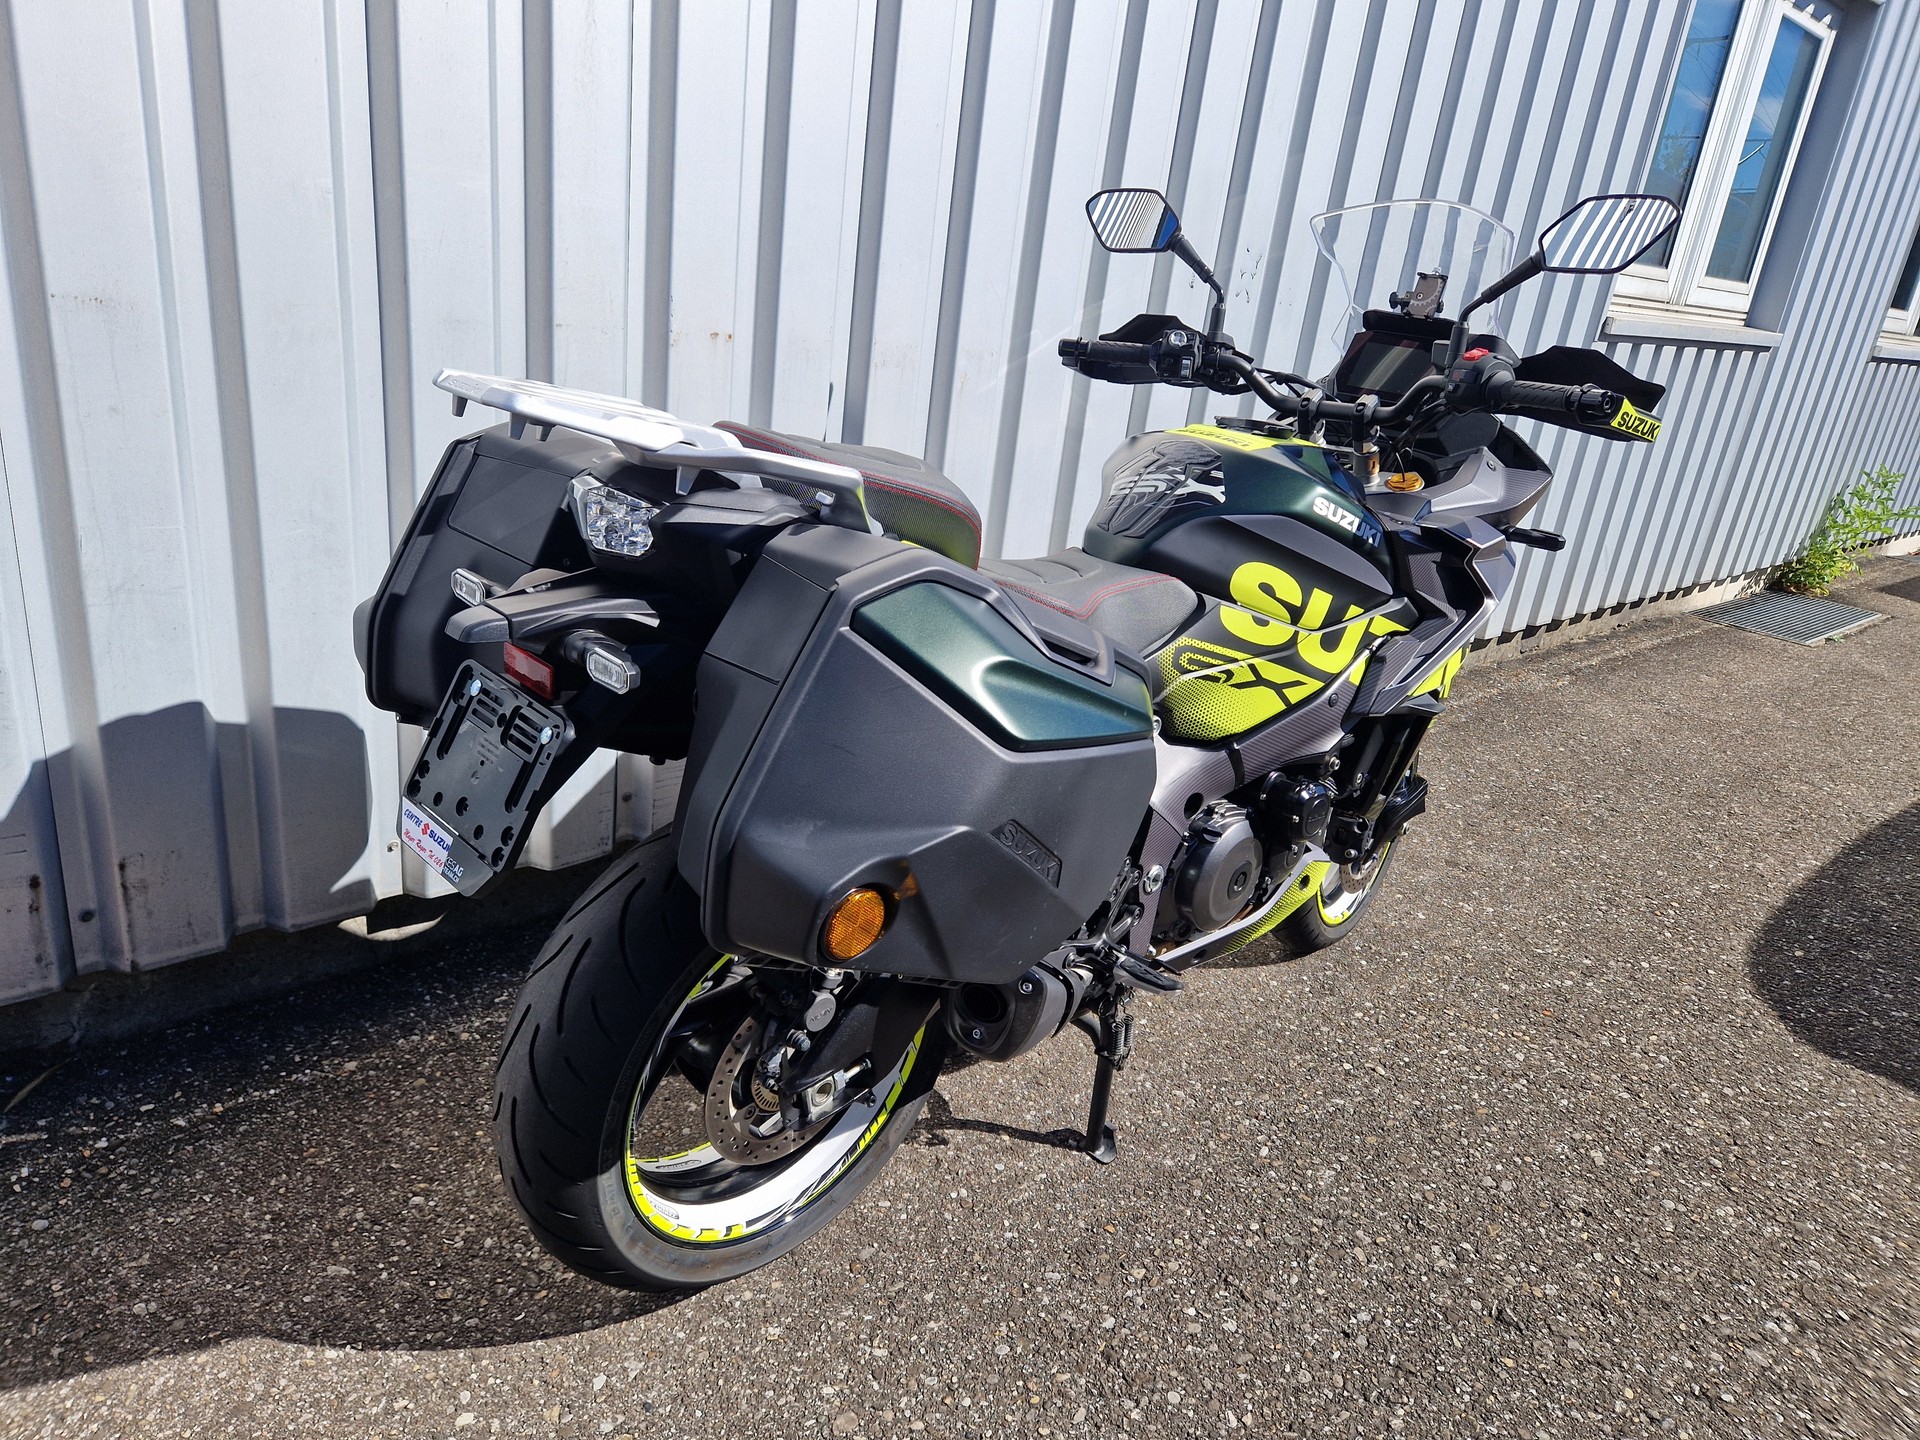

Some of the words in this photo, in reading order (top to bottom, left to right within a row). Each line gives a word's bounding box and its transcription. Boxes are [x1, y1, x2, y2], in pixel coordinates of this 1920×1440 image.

[1313, 497, 1381, 548] SUZUKI
[404, 809, 423, 828] CENTRE
[1000, 823, 1059, 882] SUZUKI
